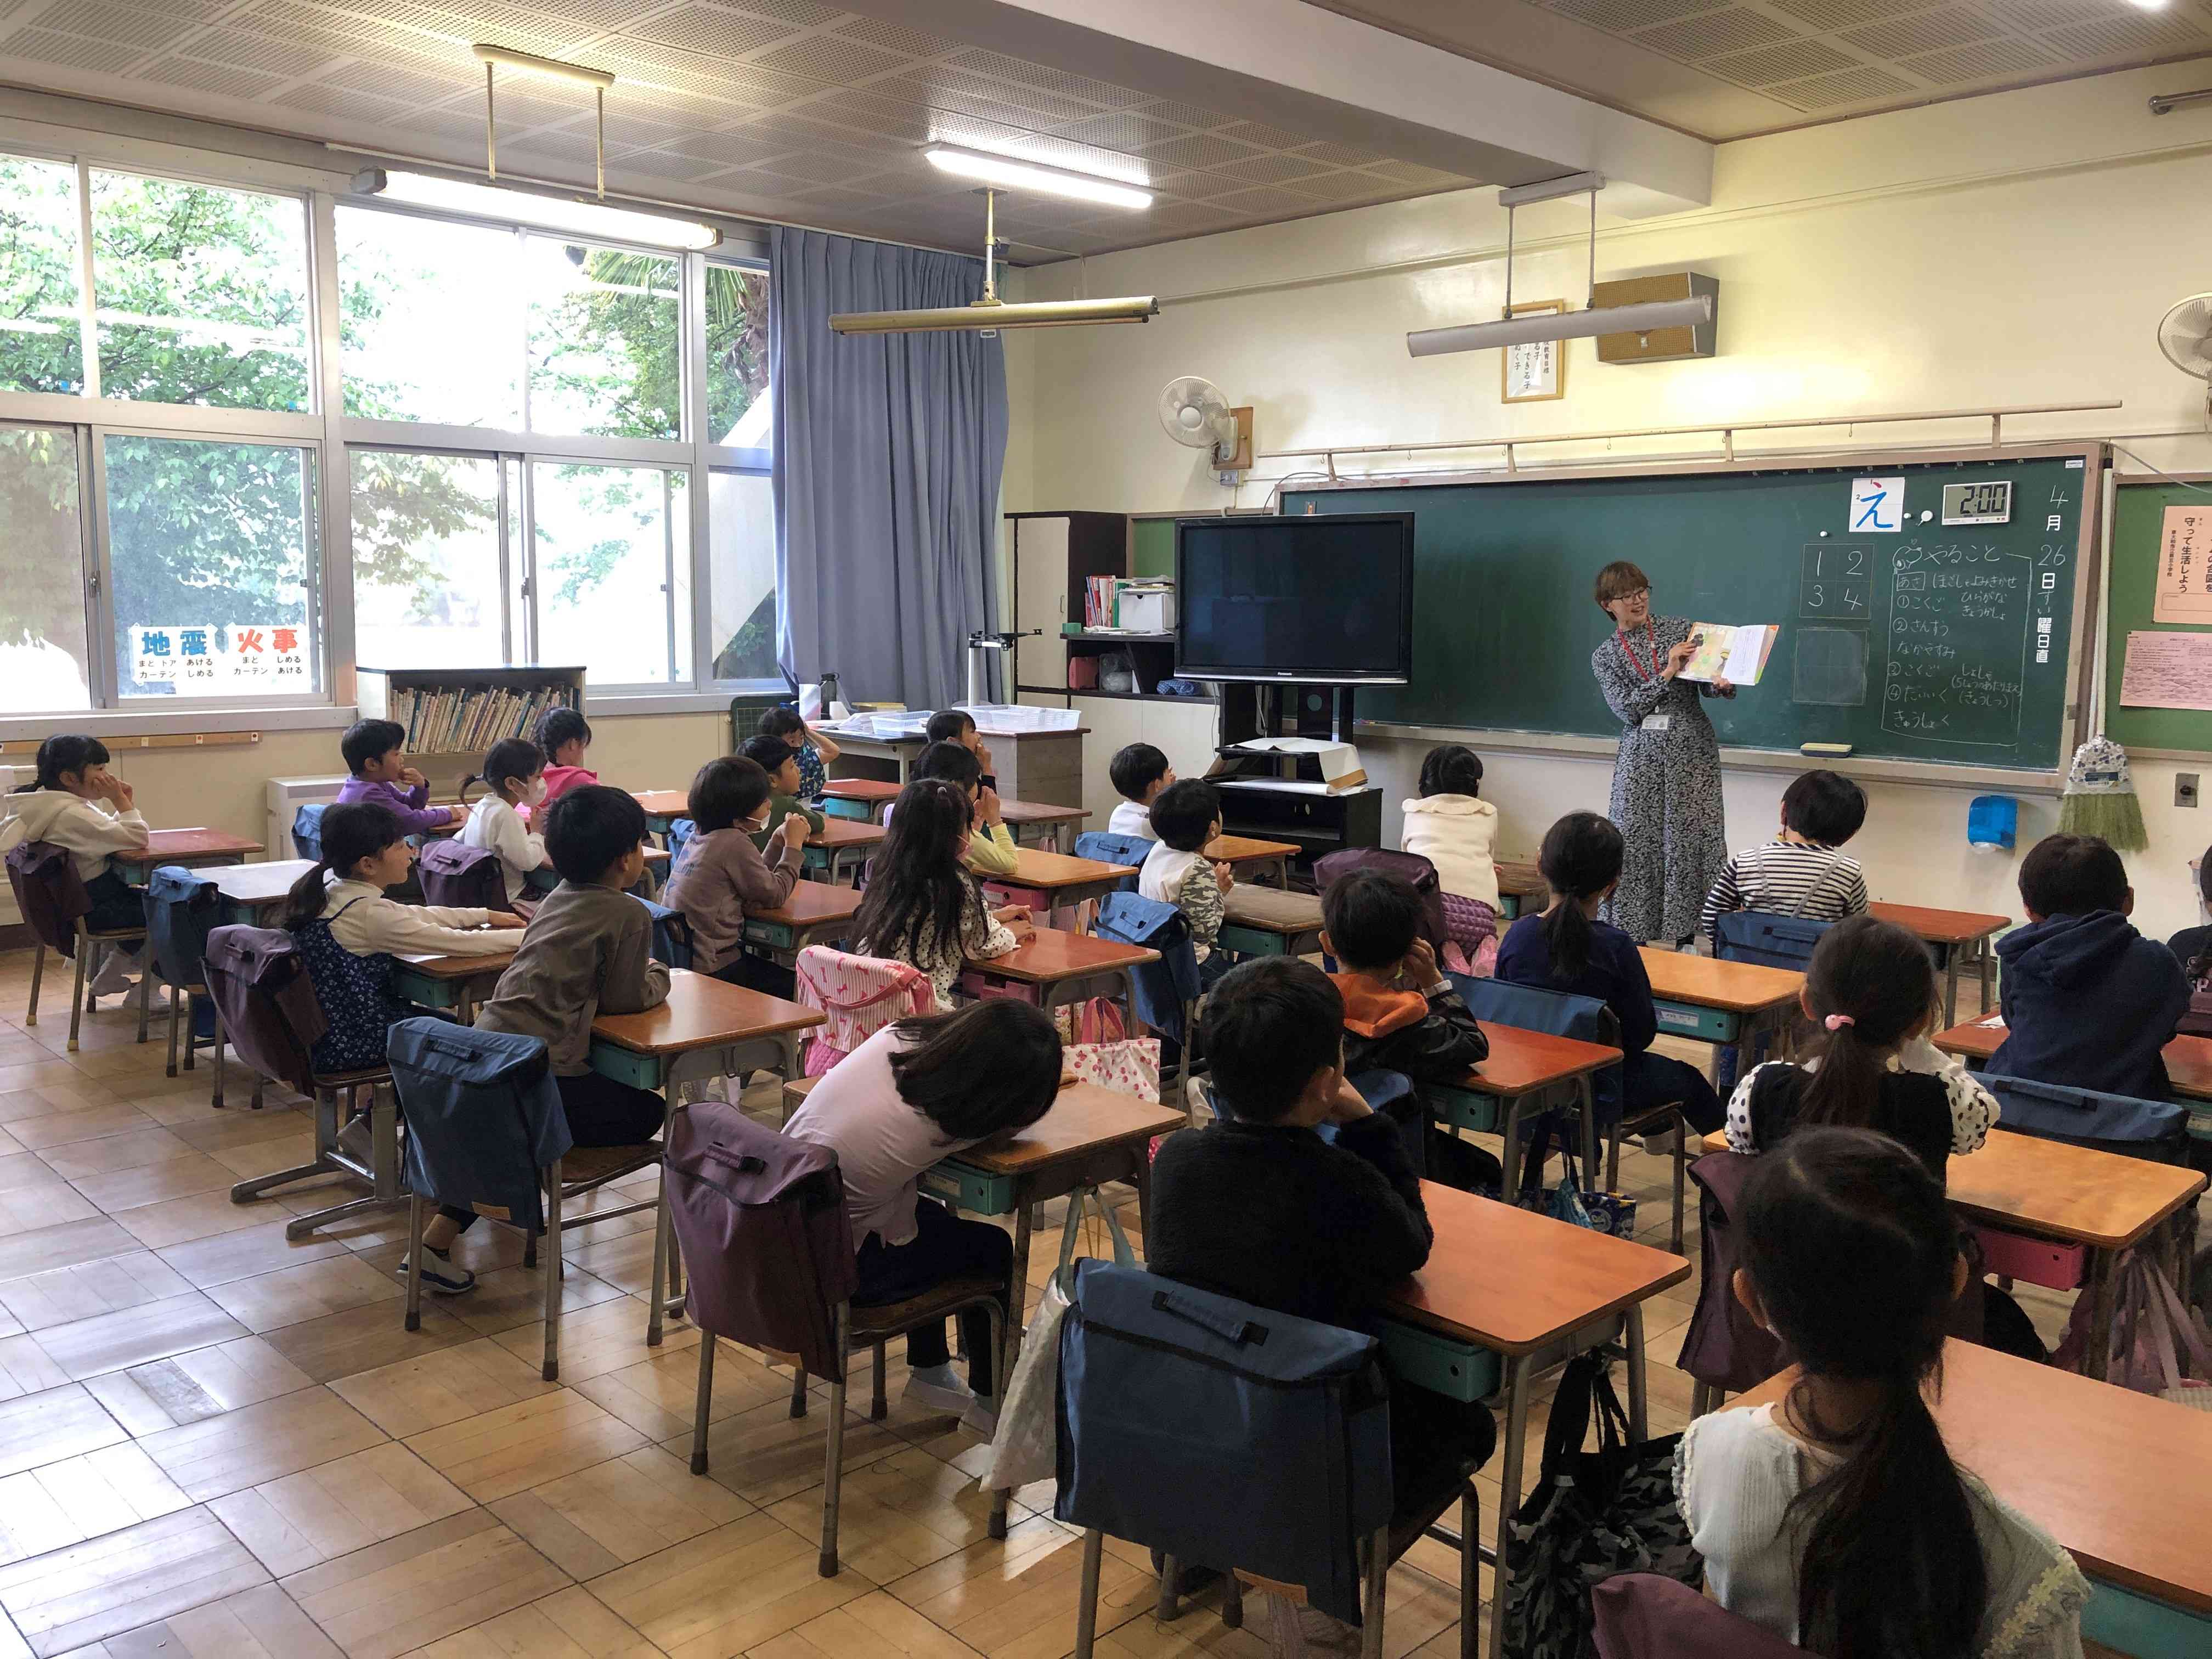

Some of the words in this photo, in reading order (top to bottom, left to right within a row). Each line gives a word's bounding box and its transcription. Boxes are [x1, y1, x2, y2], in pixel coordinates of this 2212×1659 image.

[1856, 482, 1894, 528] え
[1960, 484, 2007, 514] 2:00
[1815, 550, 1822, 577] 1
[1846, 550, 1863, 575] 2
[2179, 517, 2196, 592] 守って生活しよう
[1808, 585, 1824, 607] 3
[1843, 588, 1863, 610] 4
[142, 630, 207, 656] 地震
[238, 629, 298, 653] 火事
